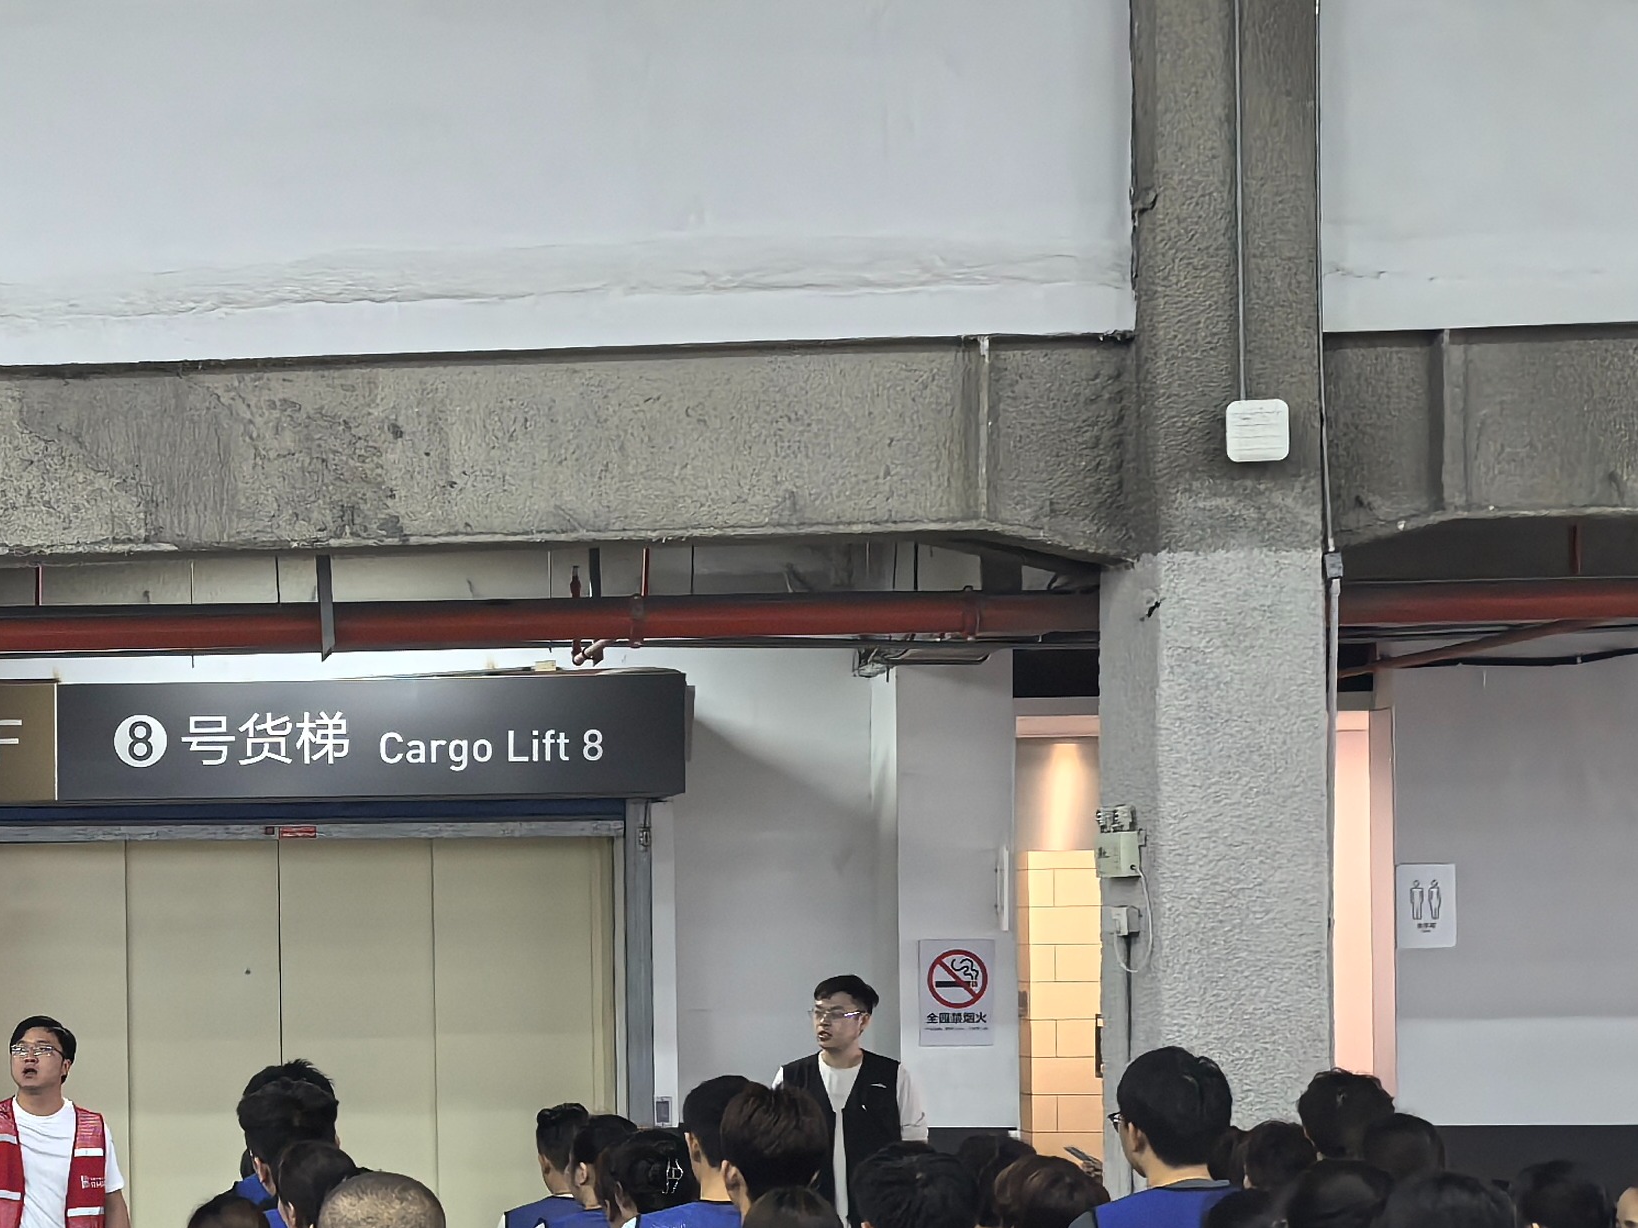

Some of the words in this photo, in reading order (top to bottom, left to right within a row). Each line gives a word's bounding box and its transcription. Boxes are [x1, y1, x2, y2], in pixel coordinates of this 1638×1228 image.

[180, 711, 350, 767] 号货梯
[378, 730, 492, 772] Cargo
[507, 729, 570, 763] Lift
[582, 729, 605, 762] 8
